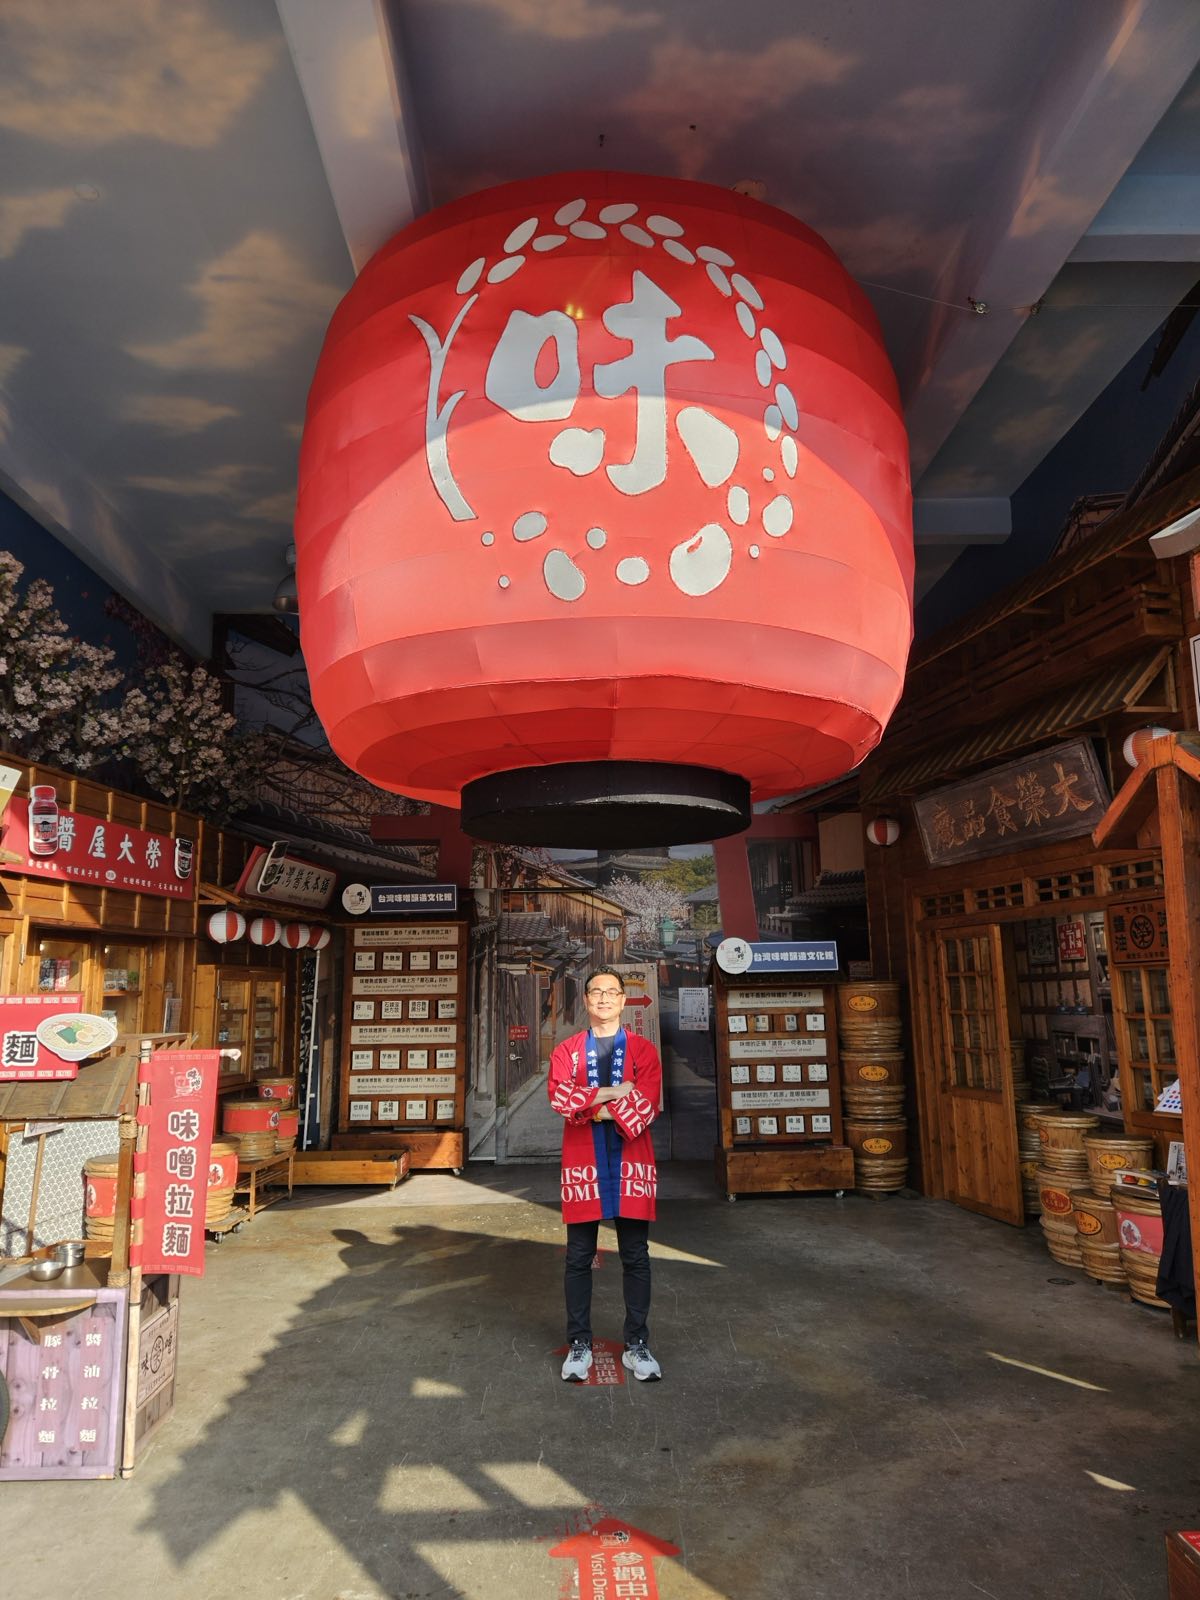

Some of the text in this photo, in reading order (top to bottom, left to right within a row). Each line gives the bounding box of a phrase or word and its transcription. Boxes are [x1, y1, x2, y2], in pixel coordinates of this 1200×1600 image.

[378, 893, 453, 904] 台灣味噌釀造文化館
[754, 951, 834, 962] 台灣味噌釀造文化館
[4, 1032, 39, 1066] 麵
[163, 1109, 200, 1256] 味噌拉麵
[591, 1552, 606, 1577] Visit
[611, 1551, 649, 1600] 參觀由
